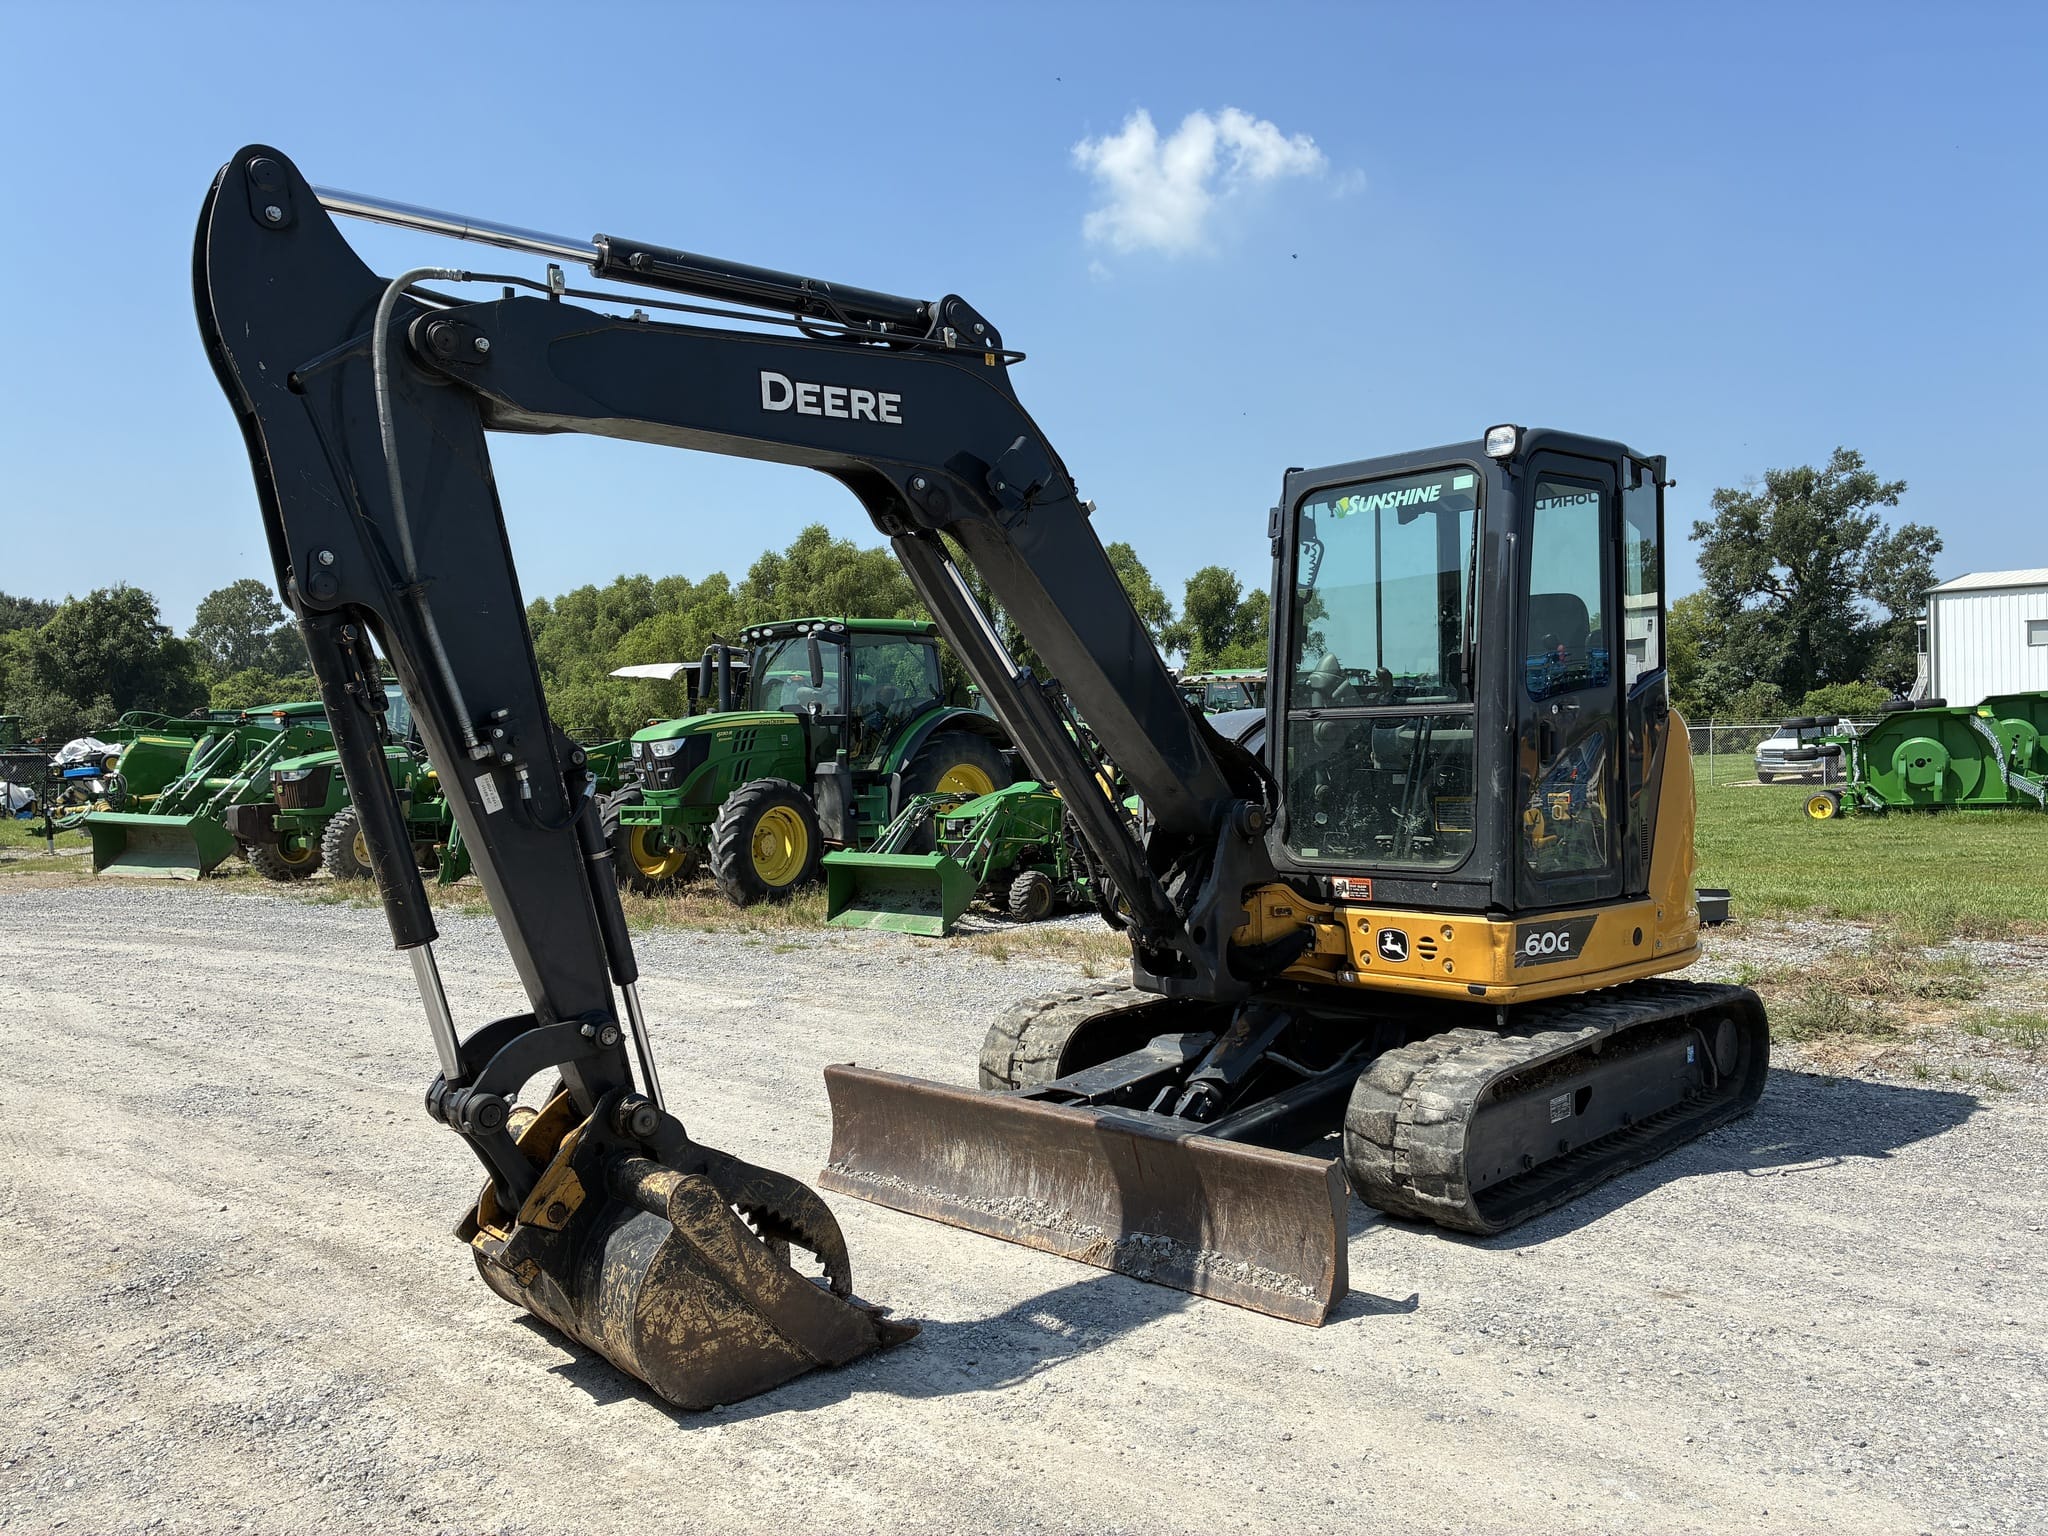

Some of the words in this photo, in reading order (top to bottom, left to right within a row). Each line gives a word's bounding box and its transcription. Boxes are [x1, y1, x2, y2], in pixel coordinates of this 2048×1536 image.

[760, 371, 903, 425] DEERE
[1346, 484, 1442, 515] SUNSHINE
[1525, 931, 1570, 956] 60G
